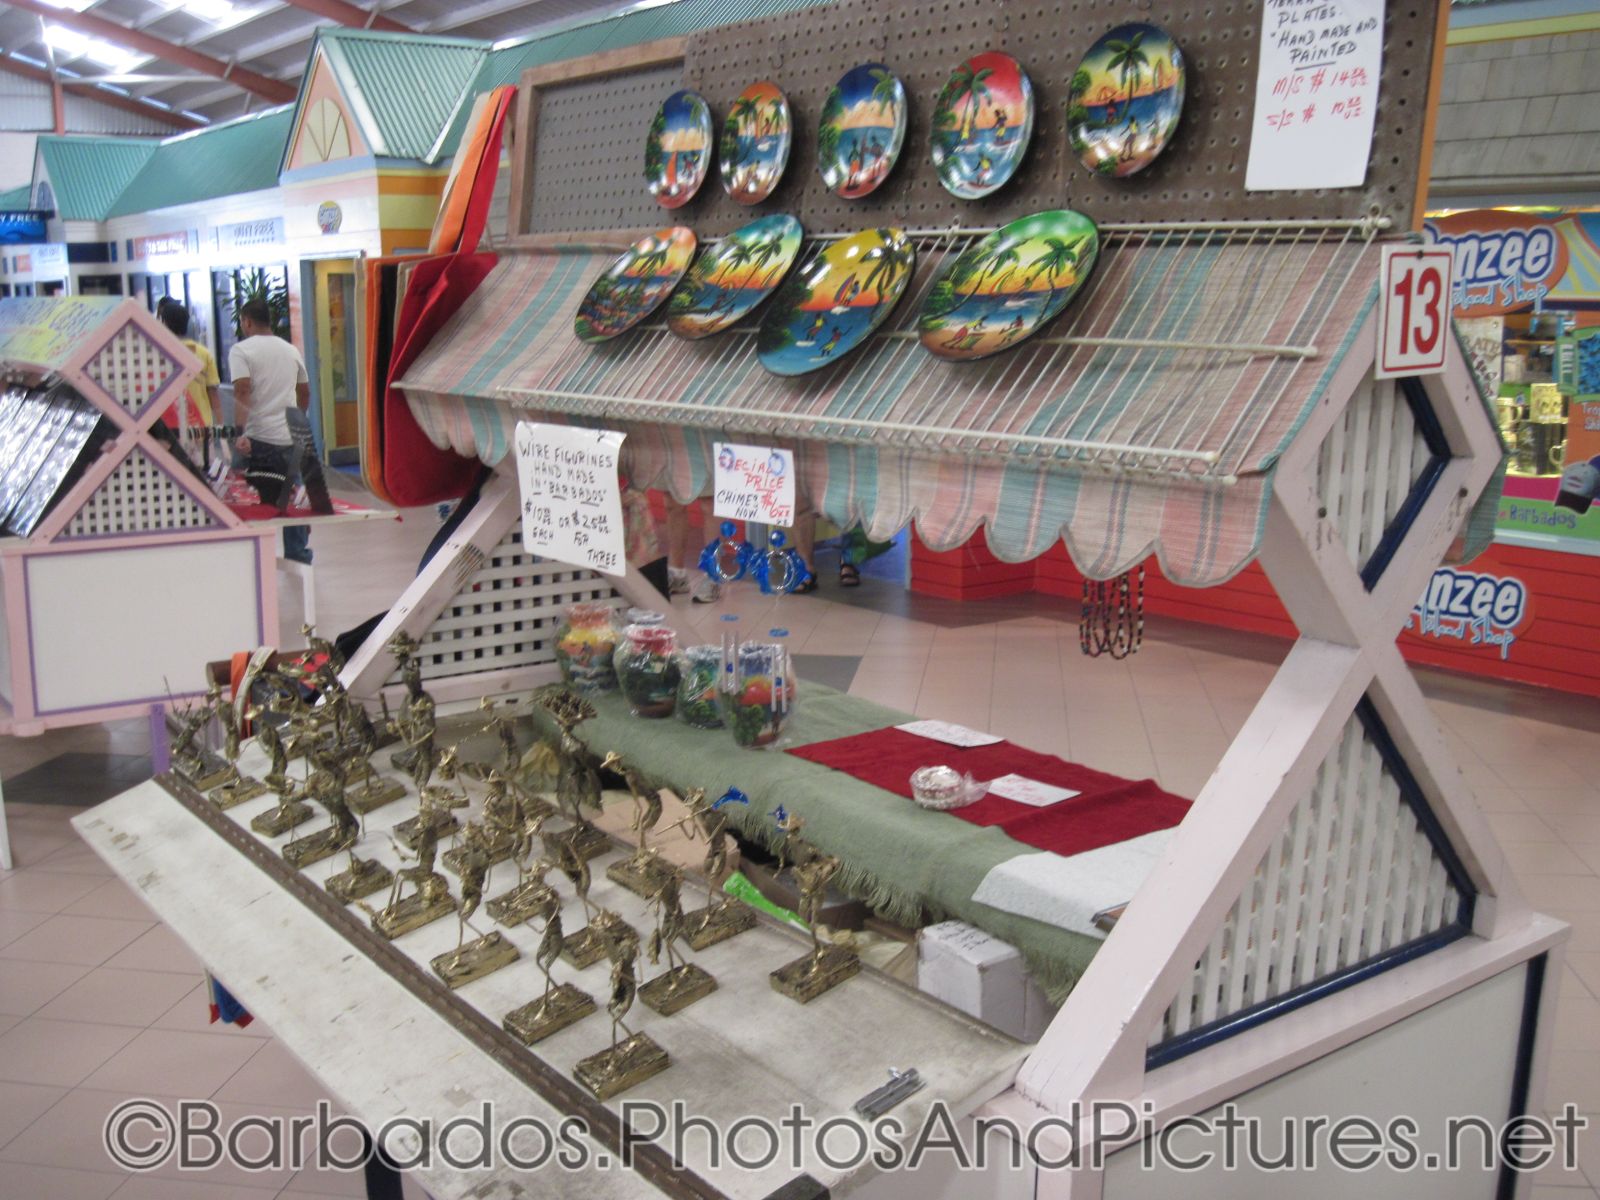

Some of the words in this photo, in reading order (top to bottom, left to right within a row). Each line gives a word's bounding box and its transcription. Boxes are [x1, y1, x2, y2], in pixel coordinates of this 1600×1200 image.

[1320, 24, 1351, 41] MADE
[1356, 17, 1378, 34] AND
[1452, 278, 1495, 310] sland
[1500, 272, 1548, 313] Shop
[1395, 267, 1442, 355] 13
[518, 441, 550, 461] WIRE
[554, 448, 613, 468] FIGURINES
[531, 477, 542, 489] IN
[533, 462, 561, 478] HAND
[567, 468, 595, 484] MADE
[745, 472, 785, 489] PRICE
[558, 516, 570, 529] OR
[1510, 504, 1577, 530] Barbados
[532, 527, 554, 540] EACH
[574, 531, 589, 546] FOR
[587, 548, 617, 567] THREE
[1414, 567, 1525, 628] nzee
[1470, 612, 1516, 660] Shop
